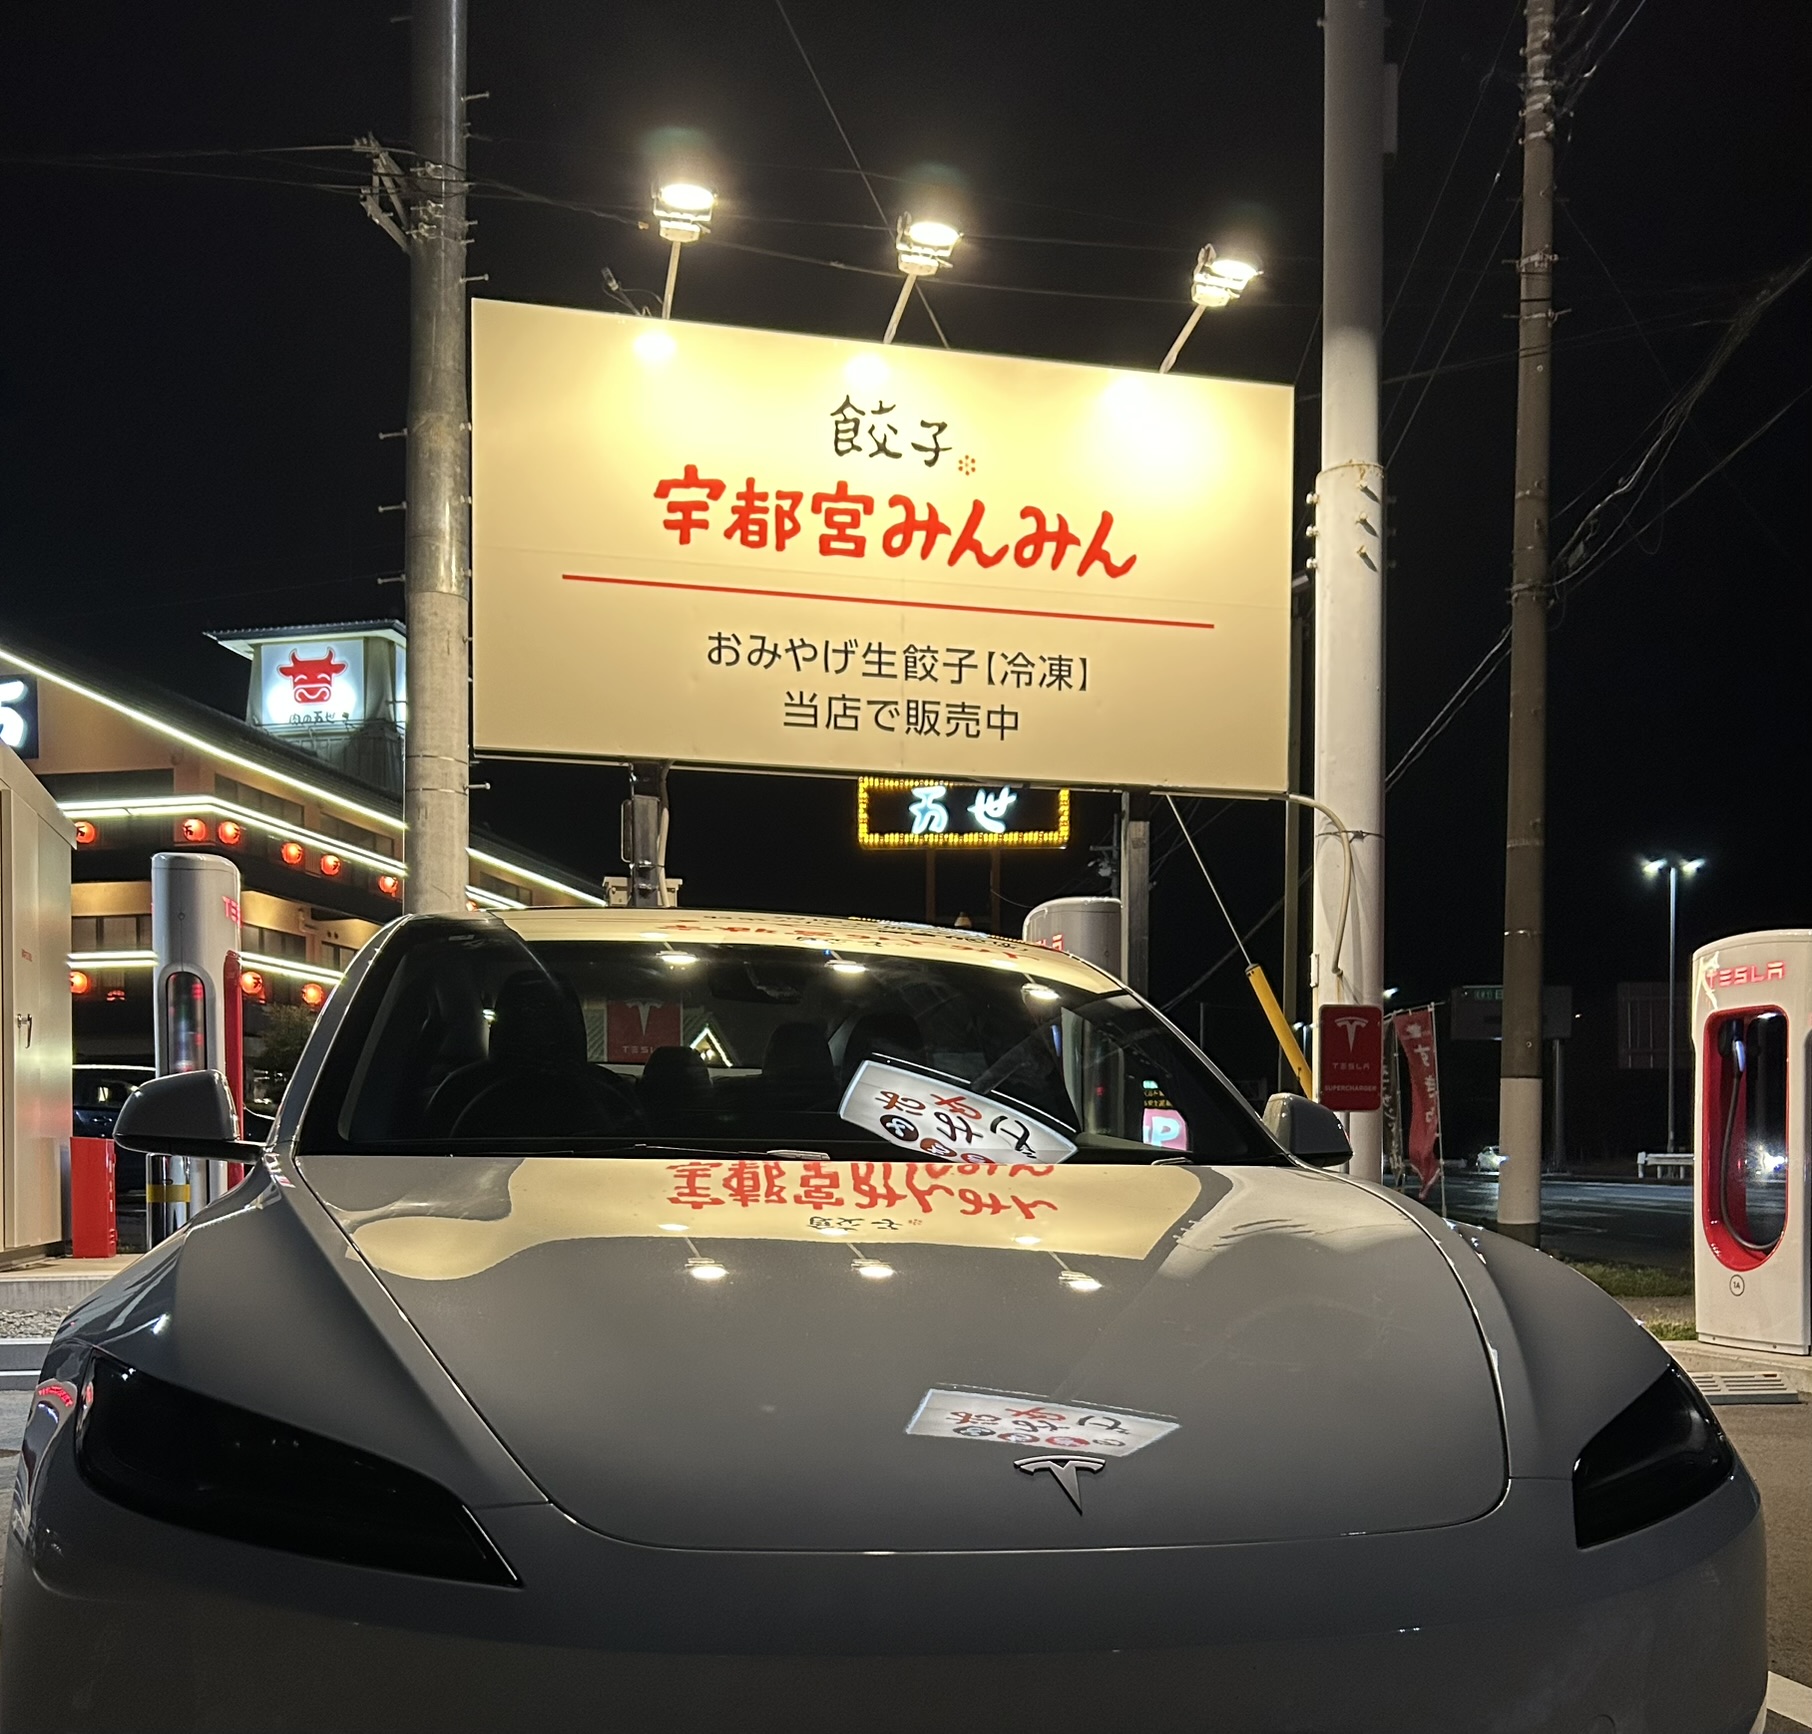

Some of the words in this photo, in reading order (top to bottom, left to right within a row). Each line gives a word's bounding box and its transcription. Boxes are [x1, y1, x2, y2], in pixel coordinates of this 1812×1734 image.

[830, 395, 952, 467] 餃子
[653, 464, 1137, 579] 宇都宮みんみん
[706, 631, 1090, 693] おみやげ生餃子【冷凍】
[783, 691, 1020, 741] 当店で販売中
[1706, 960, 1785, 988] TESLA
[1332, 1062, 1370, 1071] TESLA
